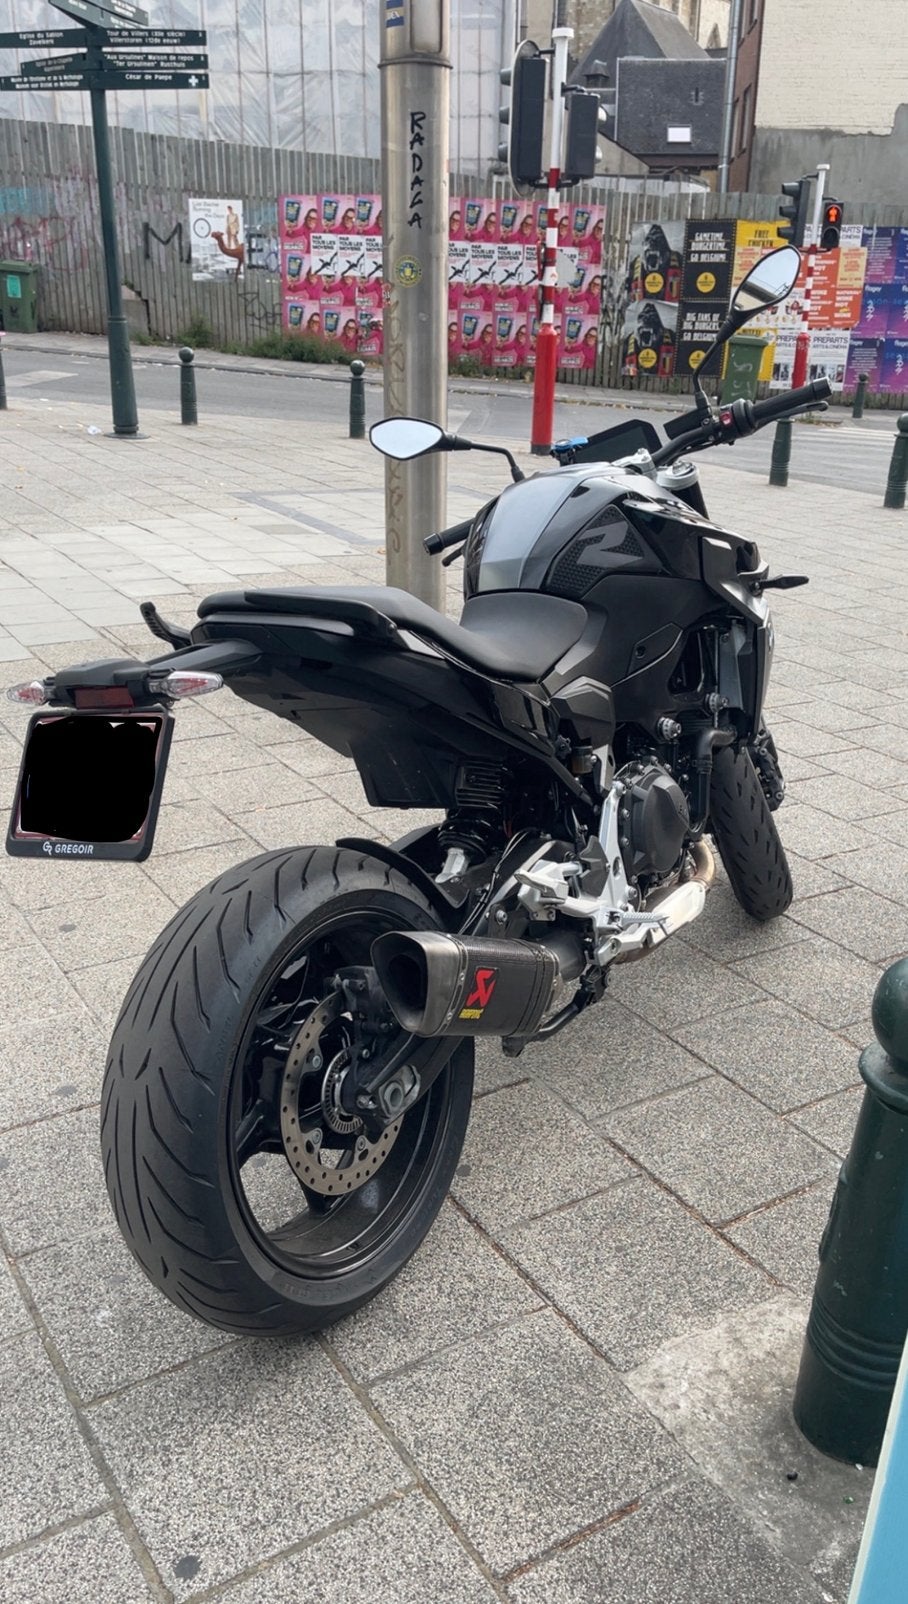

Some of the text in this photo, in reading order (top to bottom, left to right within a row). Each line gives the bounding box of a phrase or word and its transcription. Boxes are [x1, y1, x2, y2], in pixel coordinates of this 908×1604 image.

[754, 230, 769, 238] FREE
[690, 253, 699, 262] GO
[683, 332, 692, 341] GO
[54, 844, 94, 854] GREGOIR
